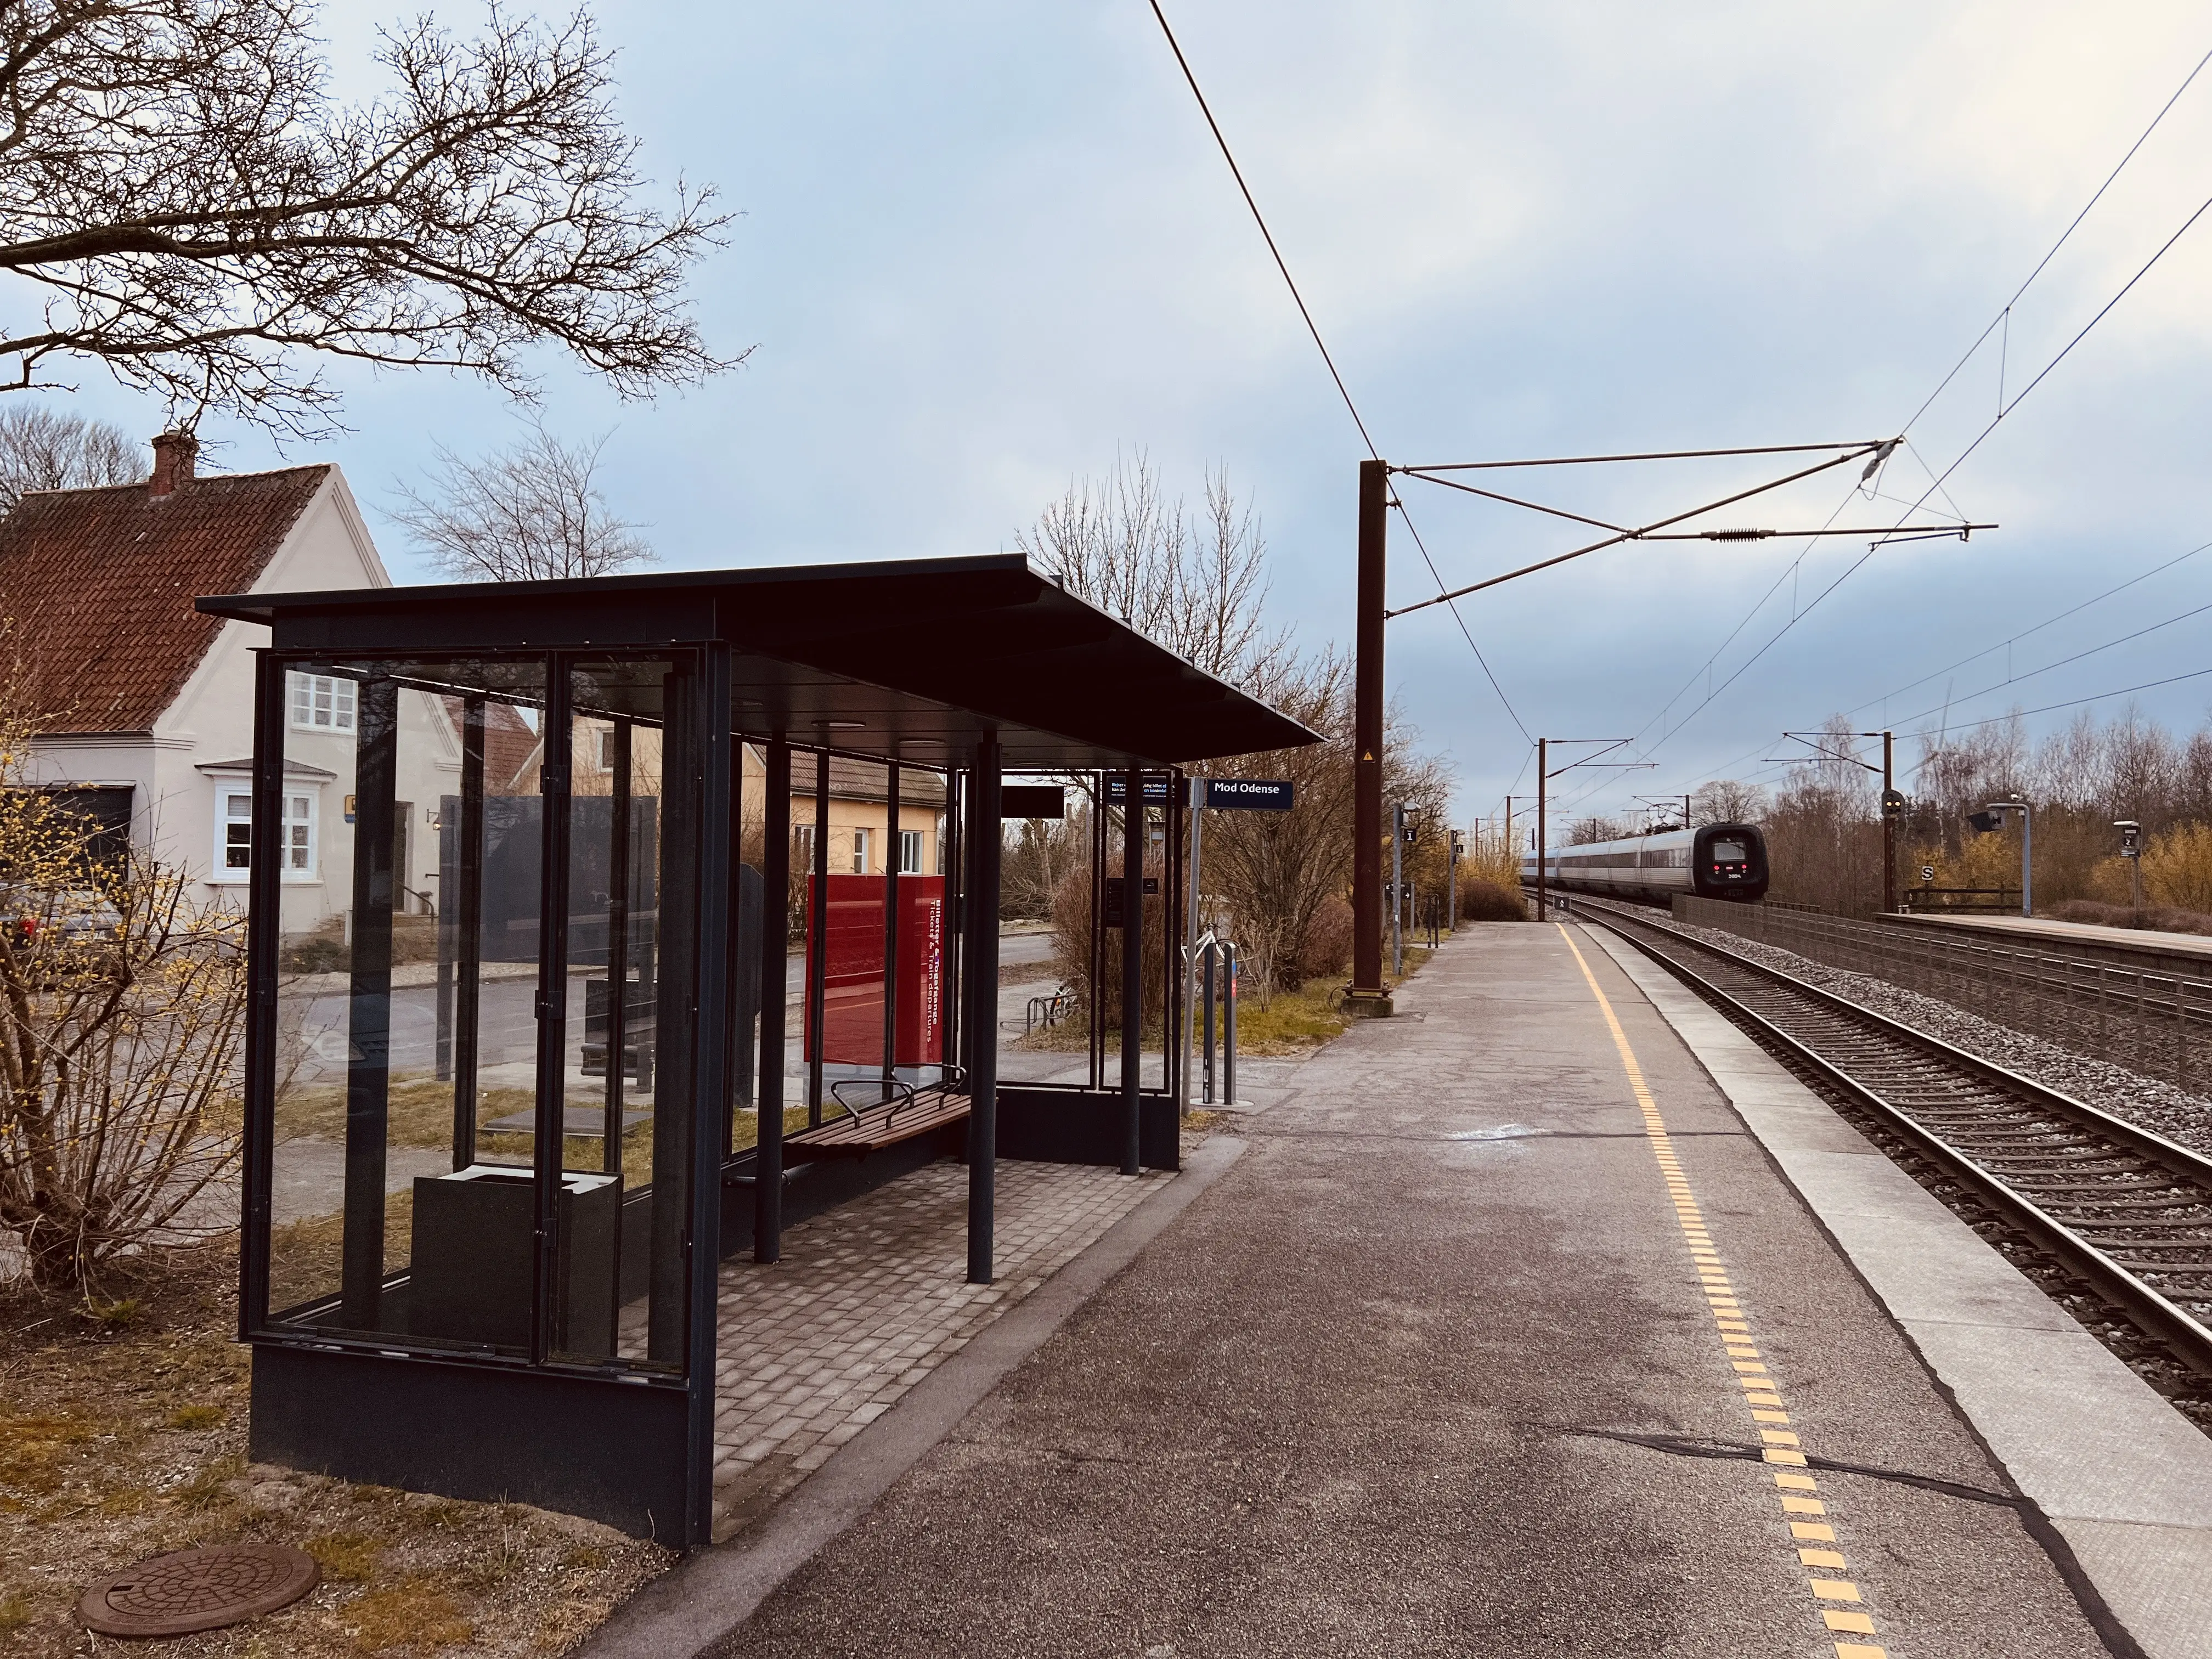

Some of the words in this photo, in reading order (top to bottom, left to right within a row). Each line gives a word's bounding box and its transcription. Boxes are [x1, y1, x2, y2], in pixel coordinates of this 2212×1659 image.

[1215, 783, 1237, 792] Mod
[1240, 783, 1280, 794] Odense
[1922, 867, 1933, 879] S
[935, 948, 940, 956] &
